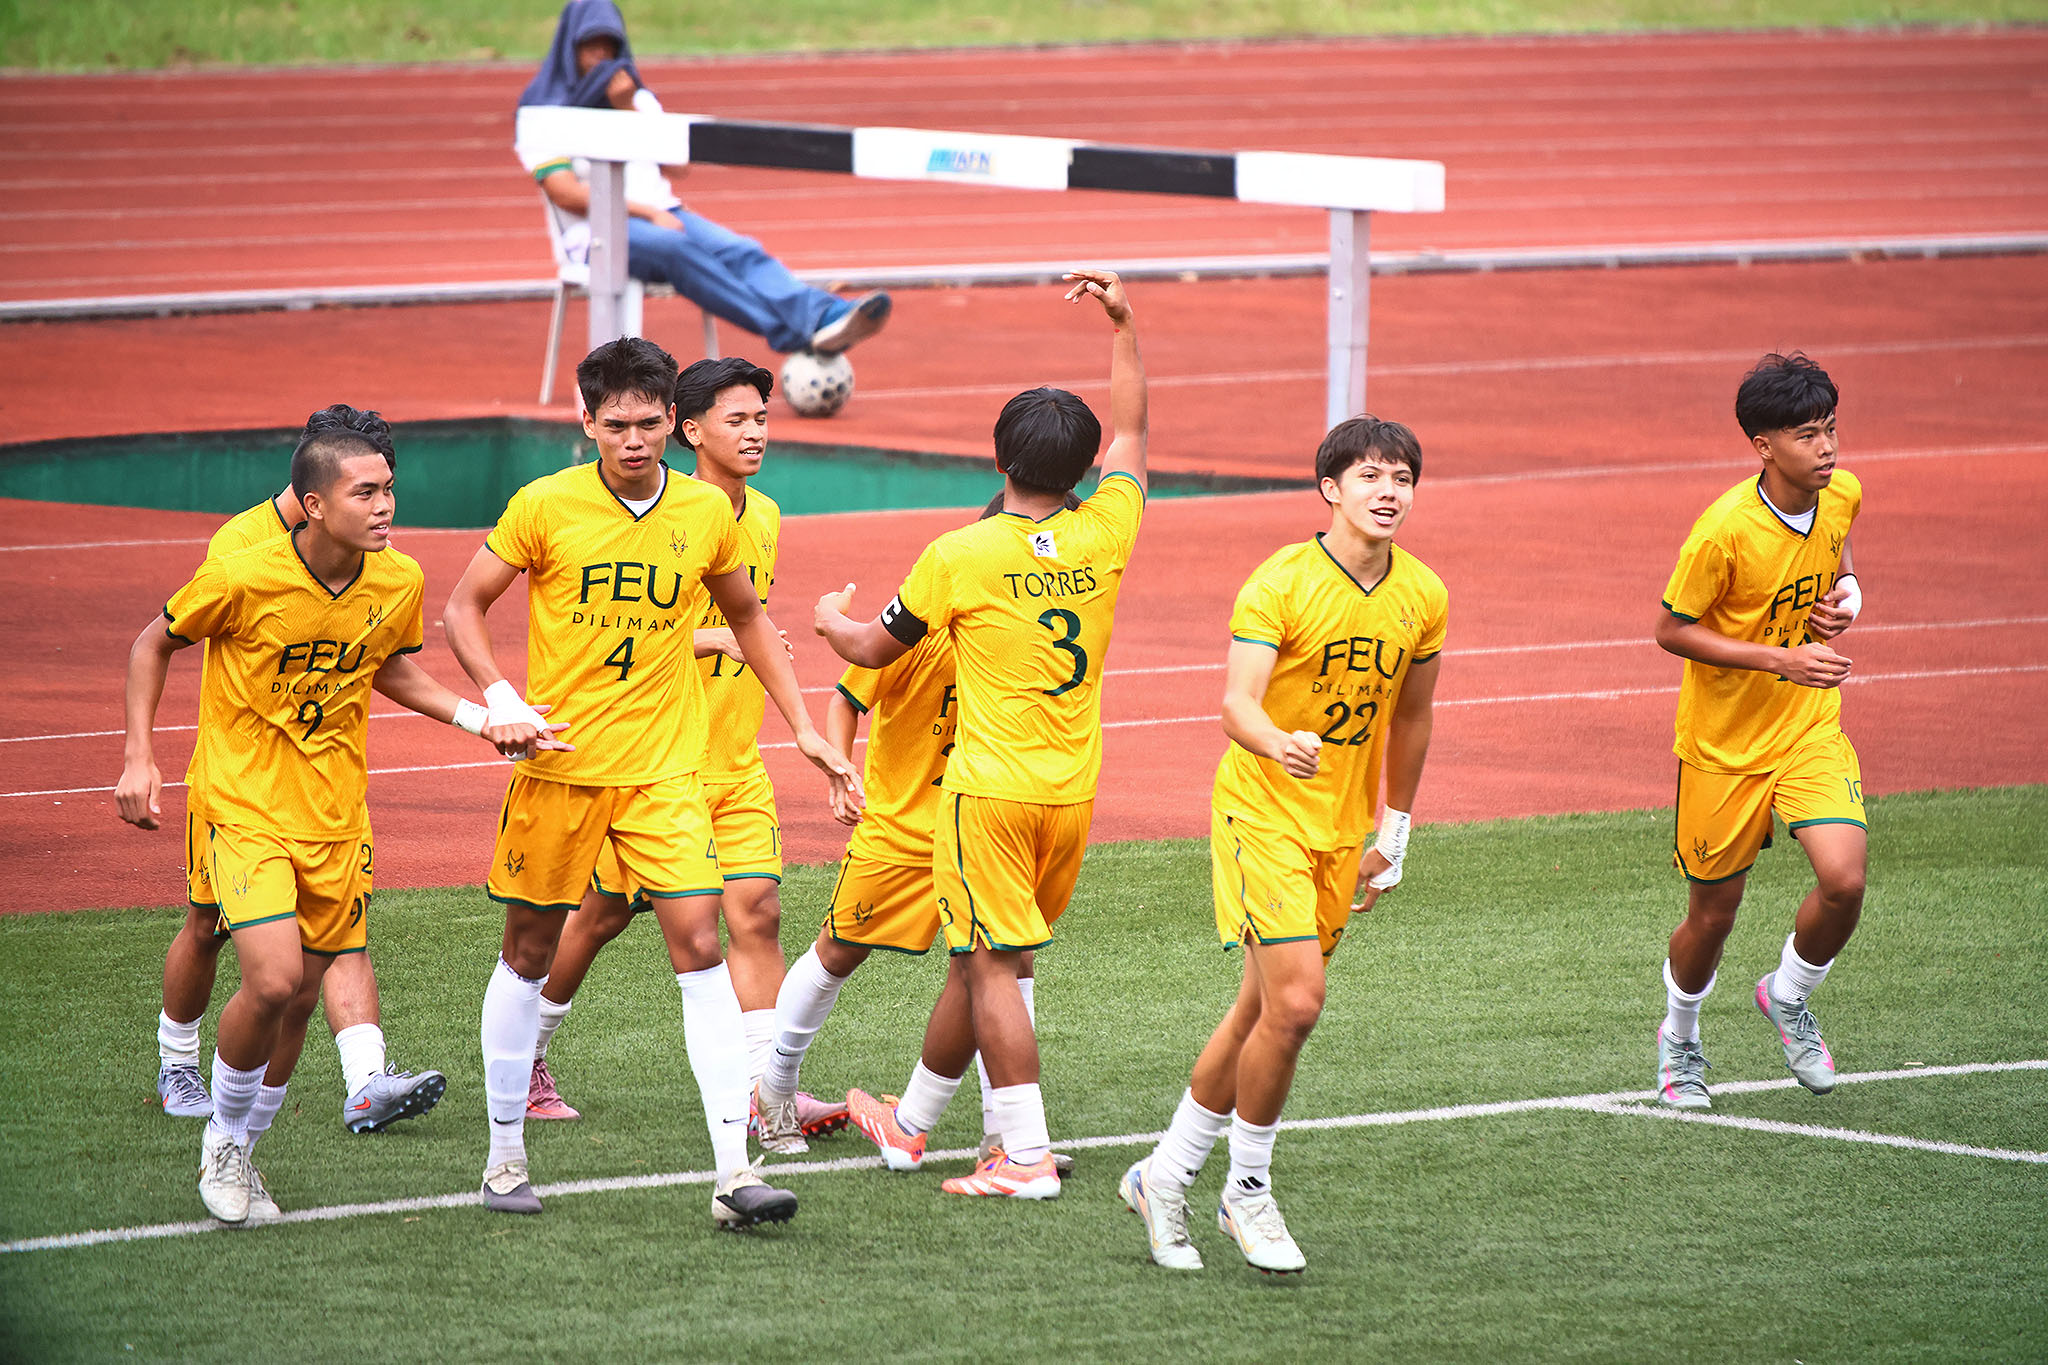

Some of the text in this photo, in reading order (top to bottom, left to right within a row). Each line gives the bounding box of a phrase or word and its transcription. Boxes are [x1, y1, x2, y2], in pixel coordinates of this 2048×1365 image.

[579, 562, 683, 609] FEU
[1004, 567, 1096, 598] TORRES
[1769, 572, 1835, 623] FEU
[572, 612, 676, 631] DILIMAN
[881, 595, 902, 625] C
[1764, 620, 1809, 637] DILI
[277, 640, 368, 676] FEU
[604, 637, 635, 681] 4
[1037, 608, 1088, 697] 3
[1318, 637, 1406, 680] FEU
[271, 682, 355, 695] DILIMA
[298, 700, 324, 742] 9
[1320, 701, 1378, 746] 22
[361, 844, 374, 875] 2
[706, 838, 719, 870] 4
[938, 897, 954, 928] 3
